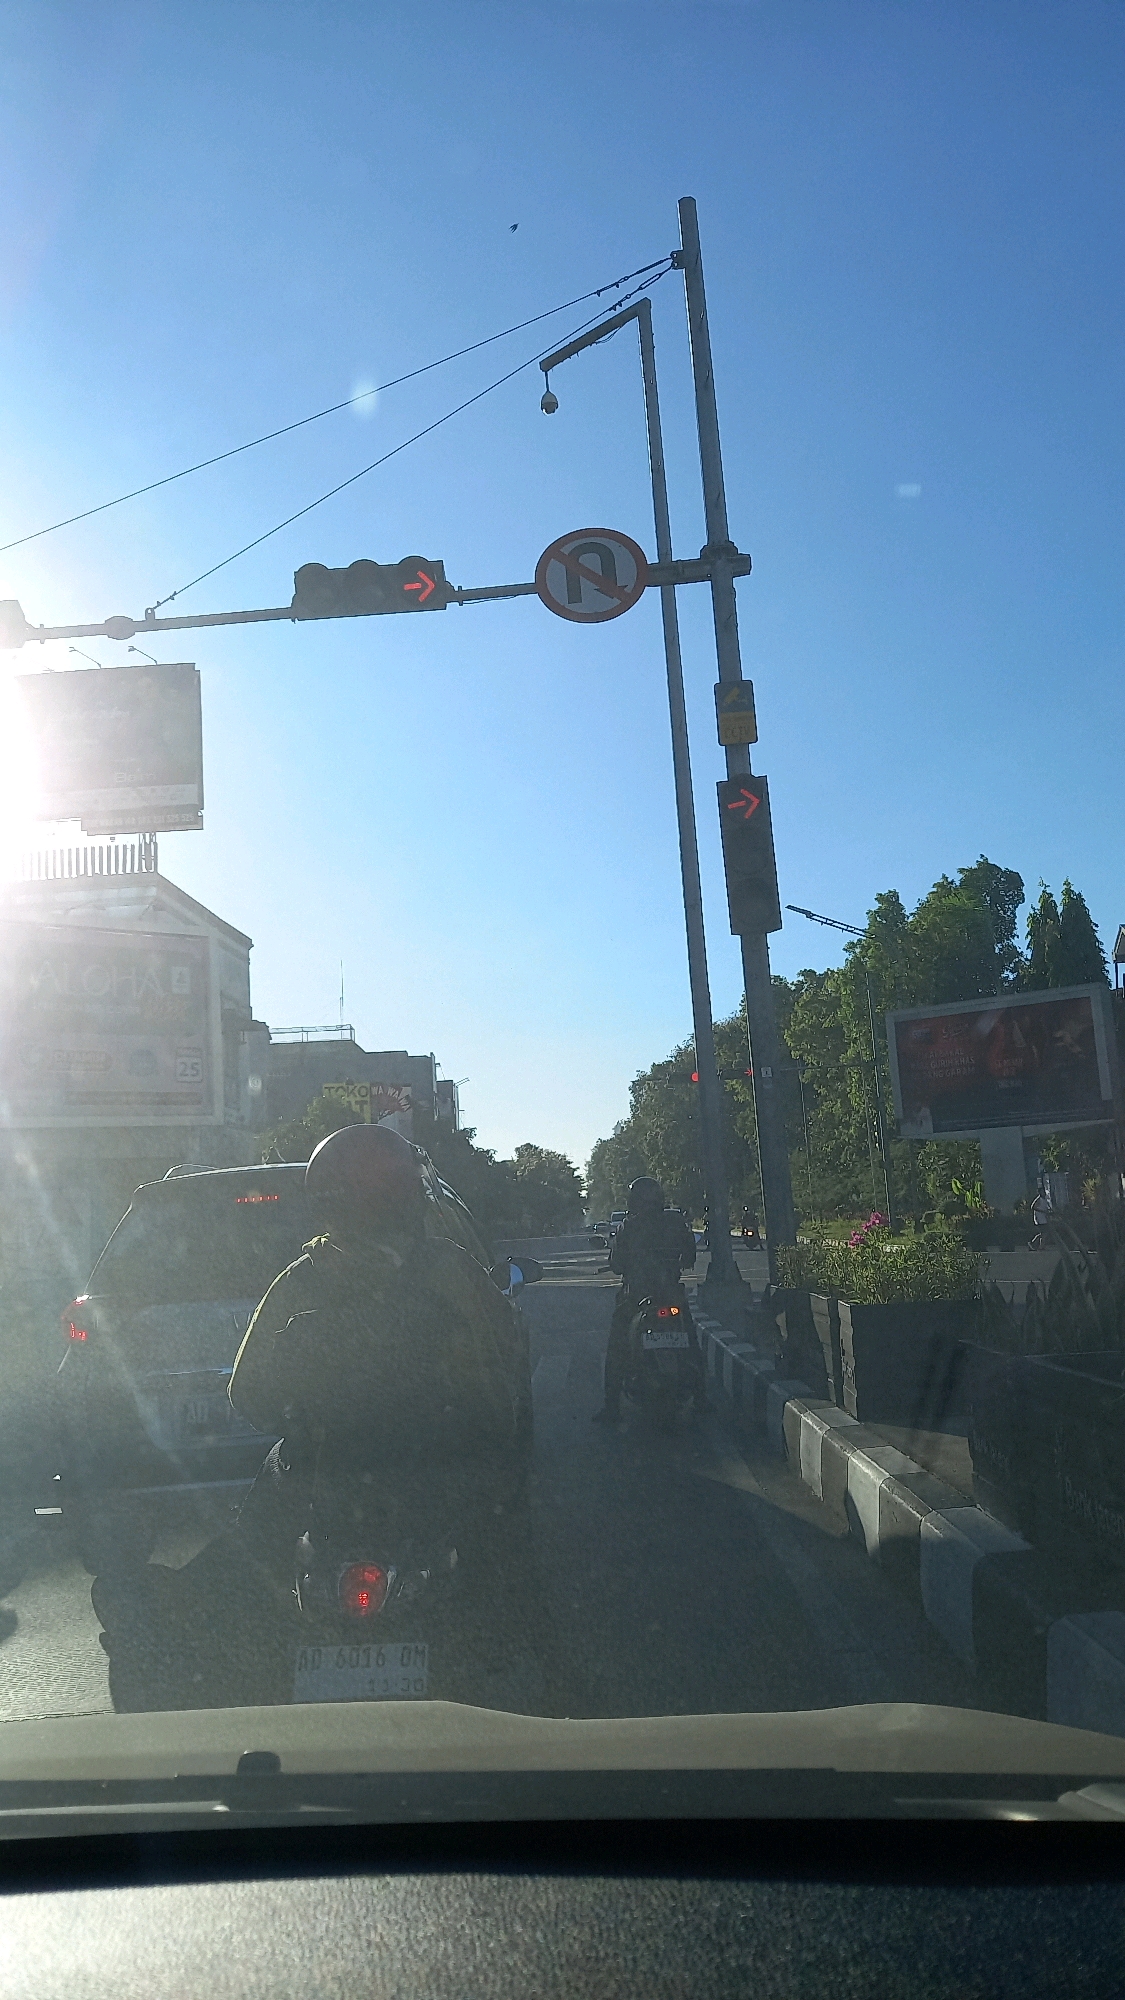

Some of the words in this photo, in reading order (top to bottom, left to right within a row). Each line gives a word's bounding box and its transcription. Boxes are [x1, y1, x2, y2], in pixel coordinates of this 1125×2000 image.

[179, 1061, 200, 1077] 25
[324, 1085, 369, 1098] TOKO
[298, 1647, 323, 1671] AD
[336, 1645, 385, 1669] 6016
